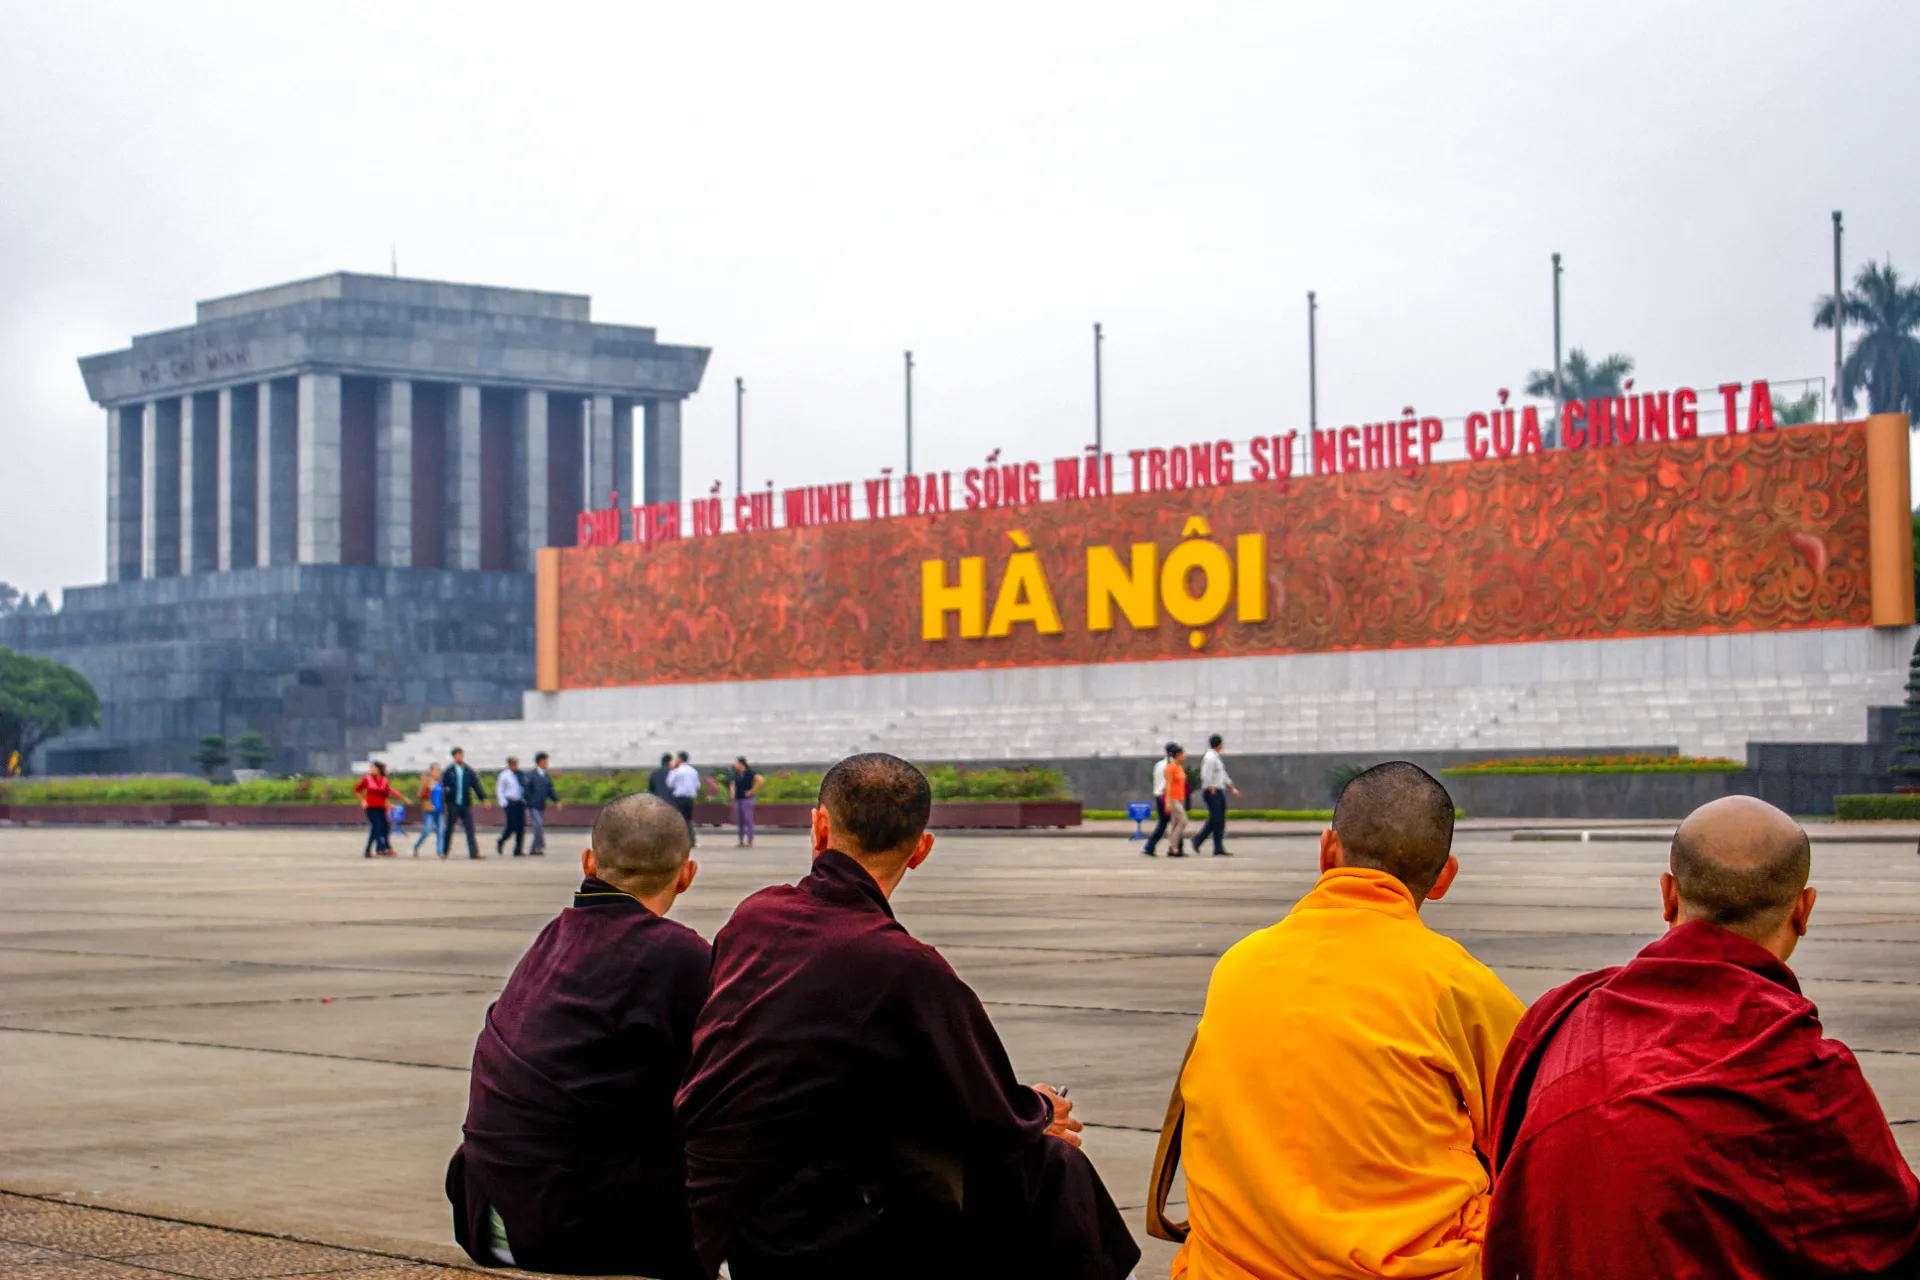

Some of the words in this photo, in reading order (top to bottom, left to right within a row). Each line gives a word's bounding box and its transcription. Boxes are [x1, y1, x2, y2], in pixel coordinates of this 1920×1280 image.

[784, 482, 851, 527] MINH
[965, 449, 1040, 510] SỐNG
[1128, 441, 1233, 498] TRONG
[1251, 429, 1297, 493] SỰ
[1313, 407, 1442, 477] NGHIỆP
[1465, 389, 1543, 460] CỦA
[1562, 379, 1698, 448] CHÚNG
[1719, 380, 1775, 433] TA
[922, 530, 1064, 641] HÀ
[1086, 516, 1267, 649] NỘI
